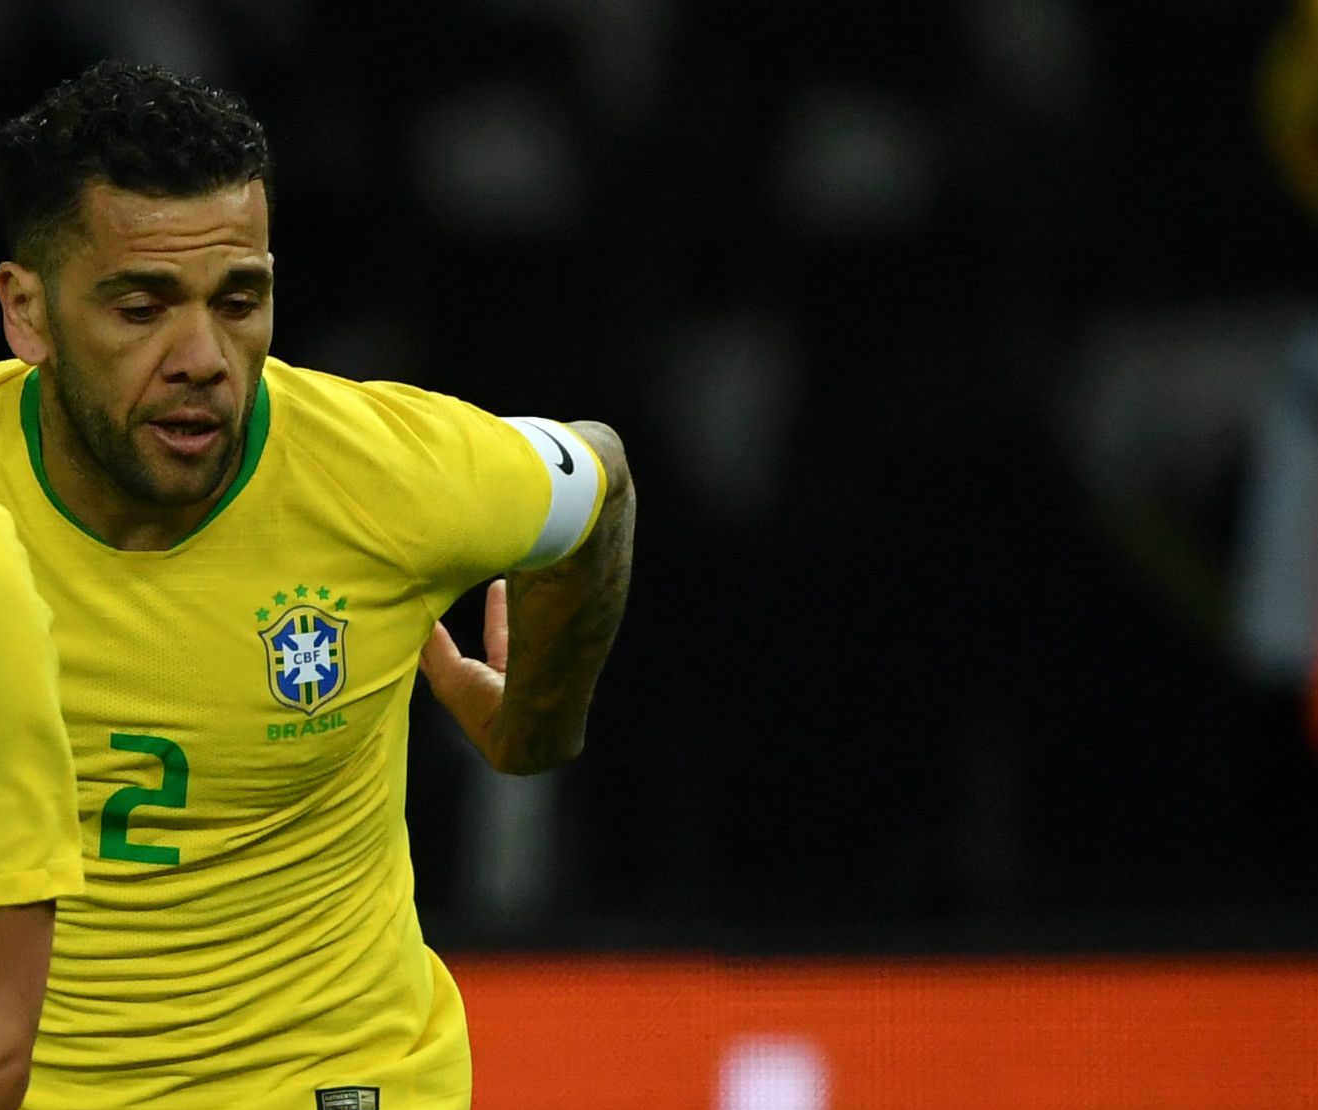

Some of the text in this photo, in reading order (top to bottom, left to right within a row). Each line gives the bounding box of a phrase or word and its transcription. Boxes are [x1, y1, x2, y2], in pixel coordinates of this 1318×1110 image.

[293, 650, 321, 665] CBF
[267, 711, 347, 741] BRASIL
[99, 732, 190, 866] 2
